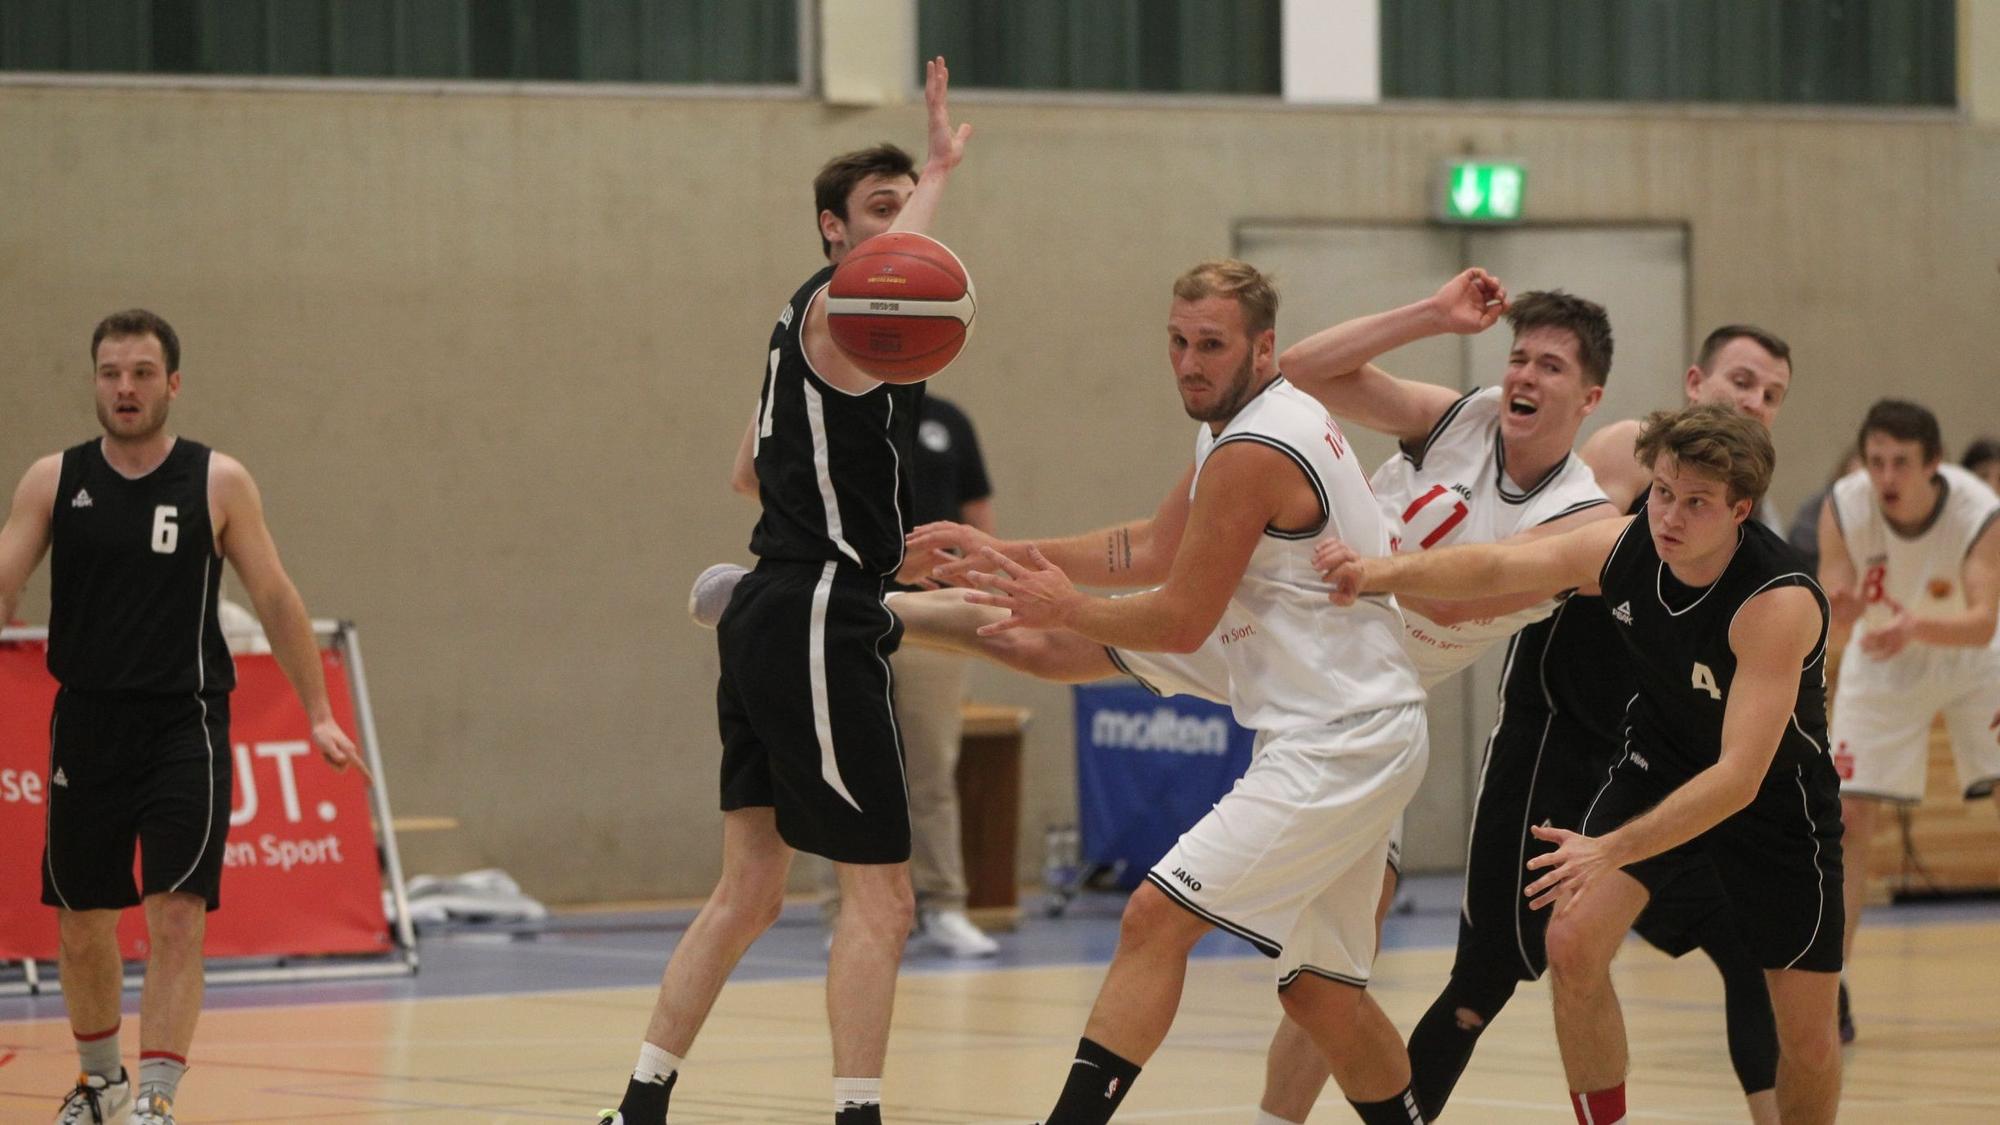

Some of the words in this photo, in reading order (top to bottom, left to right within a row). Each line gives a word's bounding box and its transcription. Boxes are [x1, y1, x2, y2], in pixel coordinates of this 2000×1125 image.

[151, 504, 179, 554] 6
[1402, 484, 1469, 550] 11
[1691, 661, 1722, 700] 4
[1091, 706, 1228, 756] molten
[0, 768, 42, 805] se
[259, 833, 344, 872] Sport
[1172, 867, 1202, 891] JAKO
